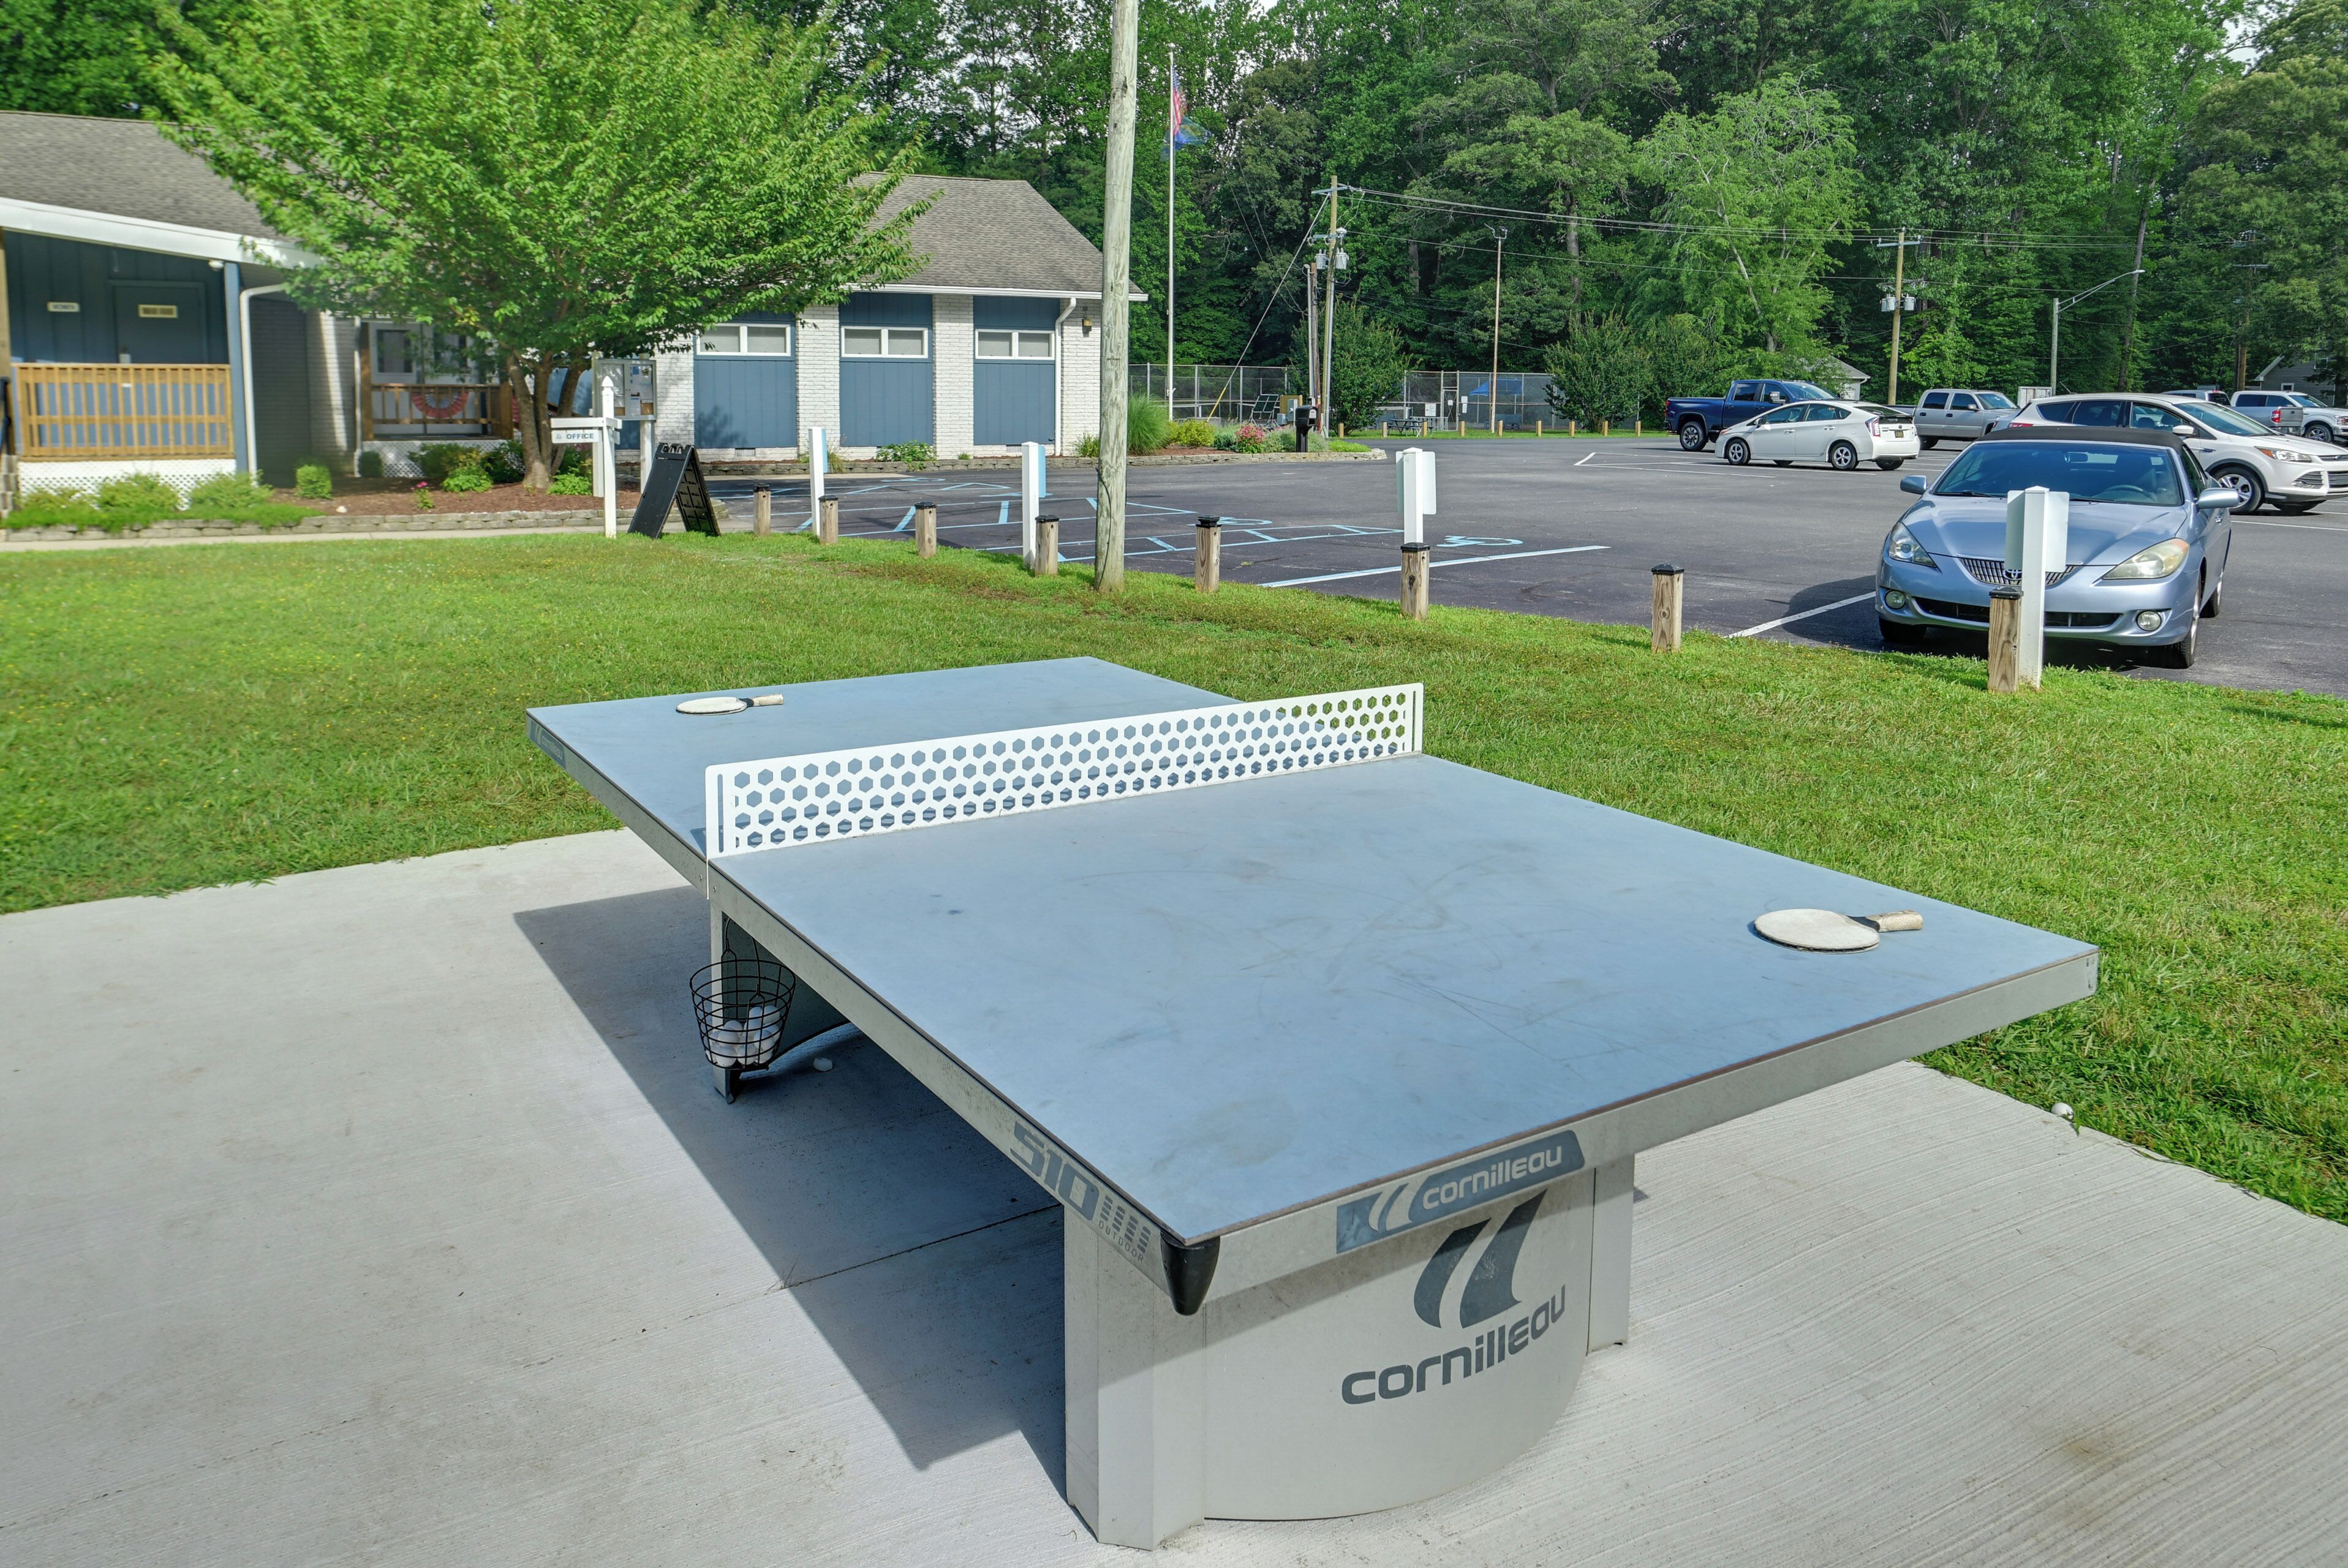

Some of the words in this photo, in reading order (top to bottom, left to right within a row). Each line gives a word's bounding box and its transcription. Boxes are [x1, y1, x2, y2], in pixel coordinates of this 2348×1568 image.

[1010, 1121, 1100, 1221] 510
[1422, 1146, 1562, 1210] cornilleau
[1099, 1221, 1144, 1264] OUTDOOR
[1342, 1284, 1566, 1404] cornilleau
